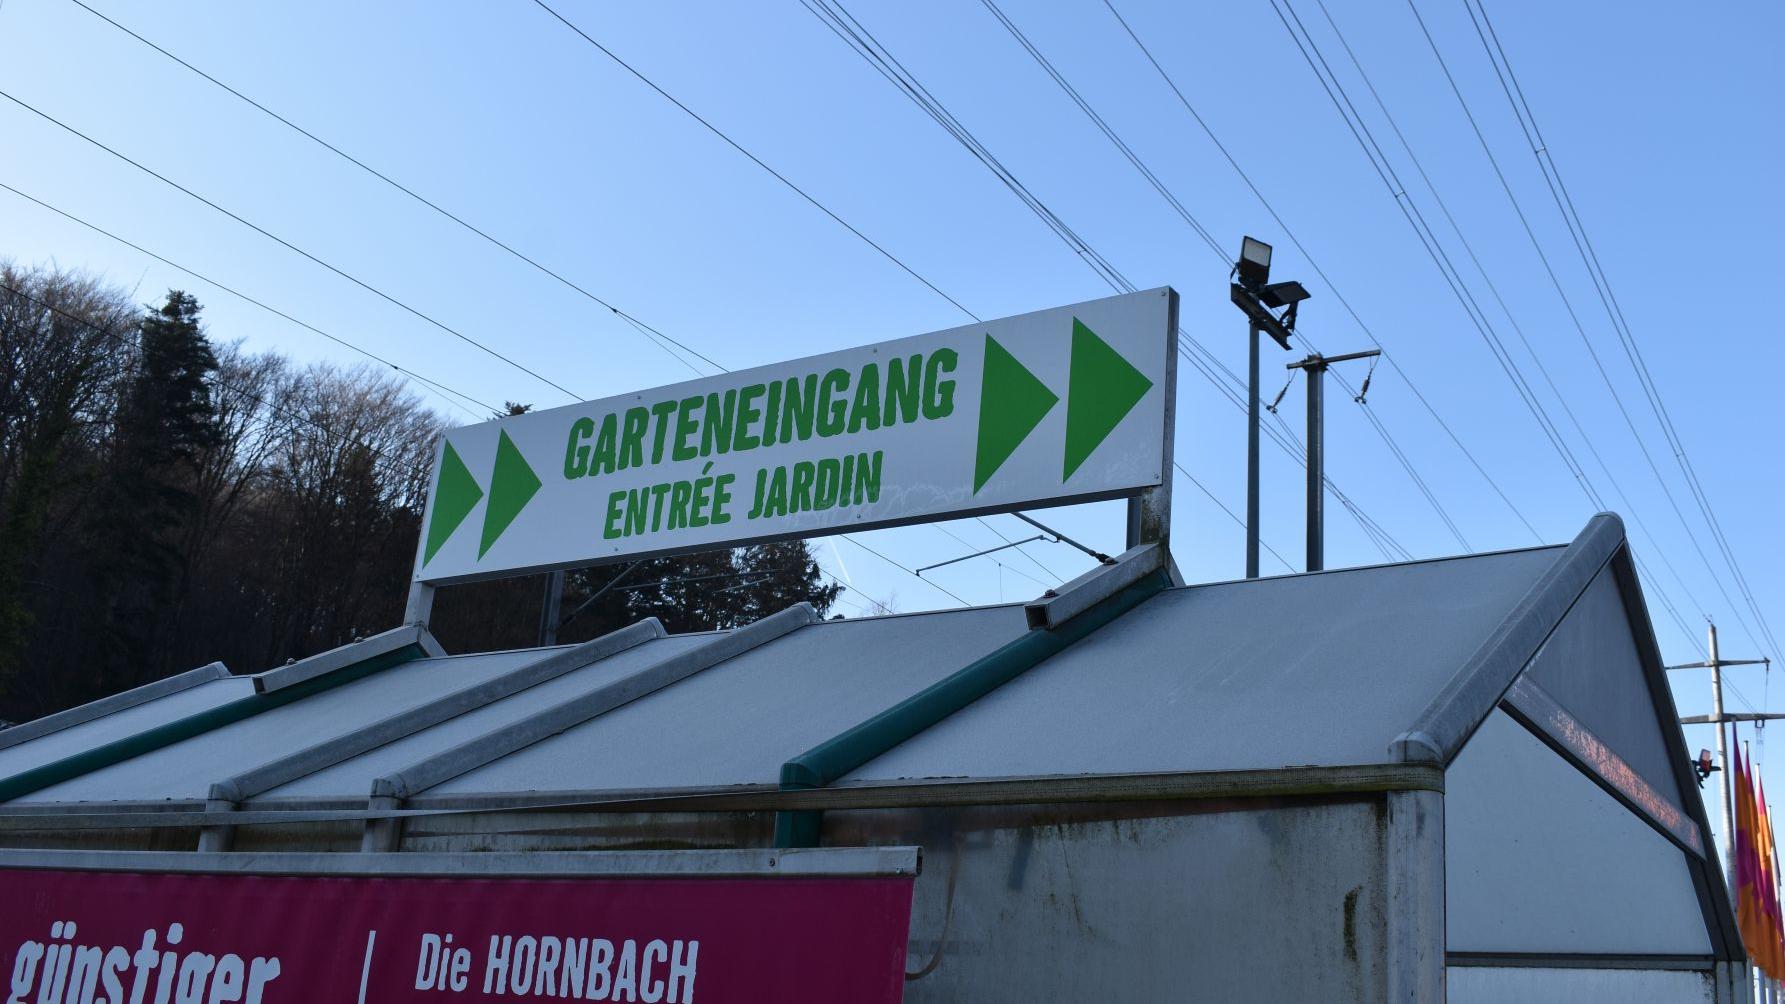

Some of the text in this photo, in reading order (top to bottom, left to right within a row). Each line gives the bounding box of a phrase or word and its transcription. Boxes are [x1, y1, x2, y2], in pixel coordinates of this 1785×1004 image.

[564, 348, 958, 480] GARTENEINGANG
[603, 451, 884, 540] ENTRÉE JARDIN
[415, 933, 699, 1004] Die HORNBACH
